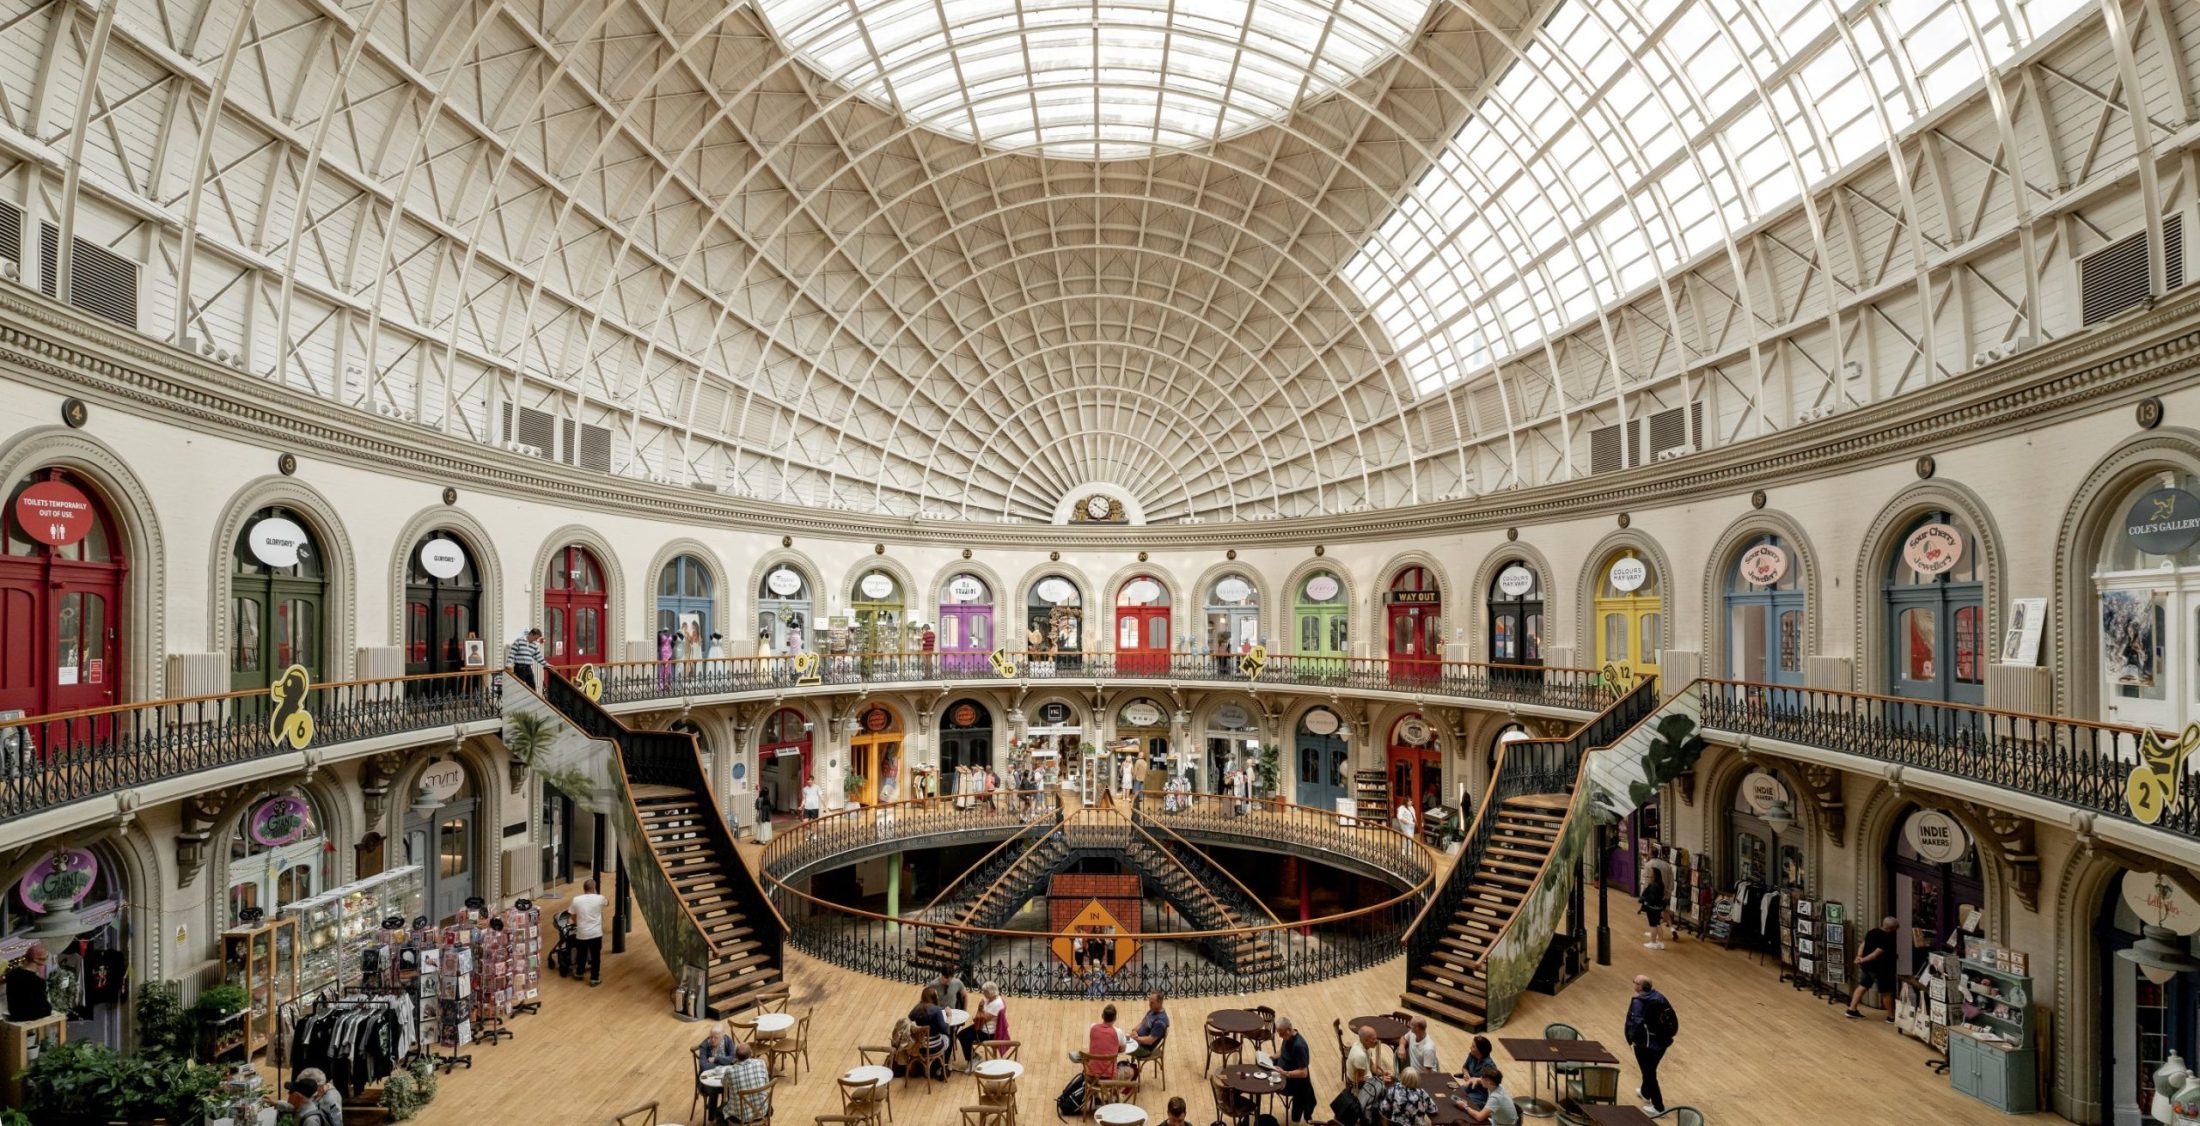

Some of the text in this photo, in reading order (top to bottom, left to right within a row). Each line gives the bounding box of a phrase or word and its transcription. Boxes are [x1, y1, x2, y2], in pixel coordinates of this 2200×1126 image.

[71, 404, 83, 420] 4
[2139, 404, 2156, 421] 13
[285, 459, 294, 469] 3
[448, 491, 454, 501] 2
[23, 498, 87, 510] TOILETS TEMPORARILY
[39, 509, 75, 519] OUT OF USE.
[2128, 518, 2200, 535] COLE'S GALLERY
[1909, 527, 1956, 550] Sour Cherry
[1744, 547, 1780, 564] Sour Cherry
[1913, 553, 1952, 571] Jewellery
[1747, 568, 1778, 583] Jewellery
[1398, 592, 1436, 601] WAY OUT
[1255, 649, 1263, 659] 11
[798, 657, 804, 667] 8
[1003, 666, 1014, 674] 10
[1620, 666, 1630, 679] 12
[592, 683, 598, 692] 7
[296, 720, 305, 739] 6
[1754, 785, 1774, 796] INDIE
[2138, 781, 2150, 810] 2
[1920, 825, 1949, 838] INDIE
[1921, 838, 1950, 847] MAKERS
[1090, 911, 1100, 921] IN
